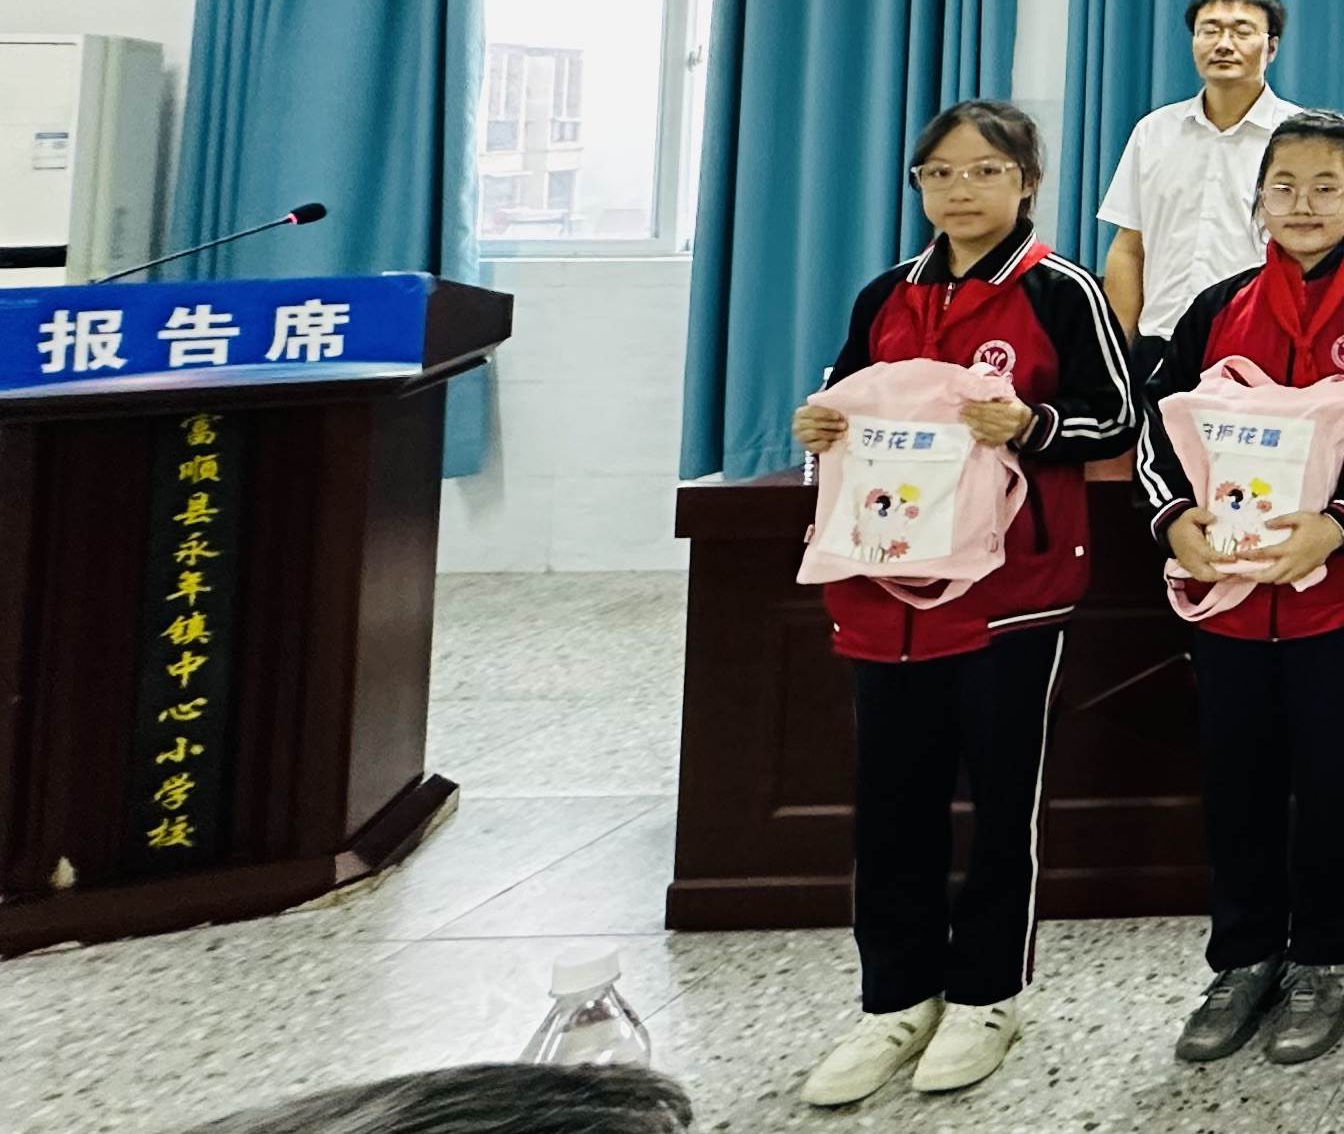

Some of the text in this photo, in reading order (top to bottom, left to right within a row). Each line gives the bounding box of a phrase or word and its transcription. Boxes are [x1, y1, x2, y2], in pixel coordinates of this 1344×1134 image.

[37, 298, 350, 373] 报告席
[147, 414, 222, 849] 富顺县永年镇中心小学校
